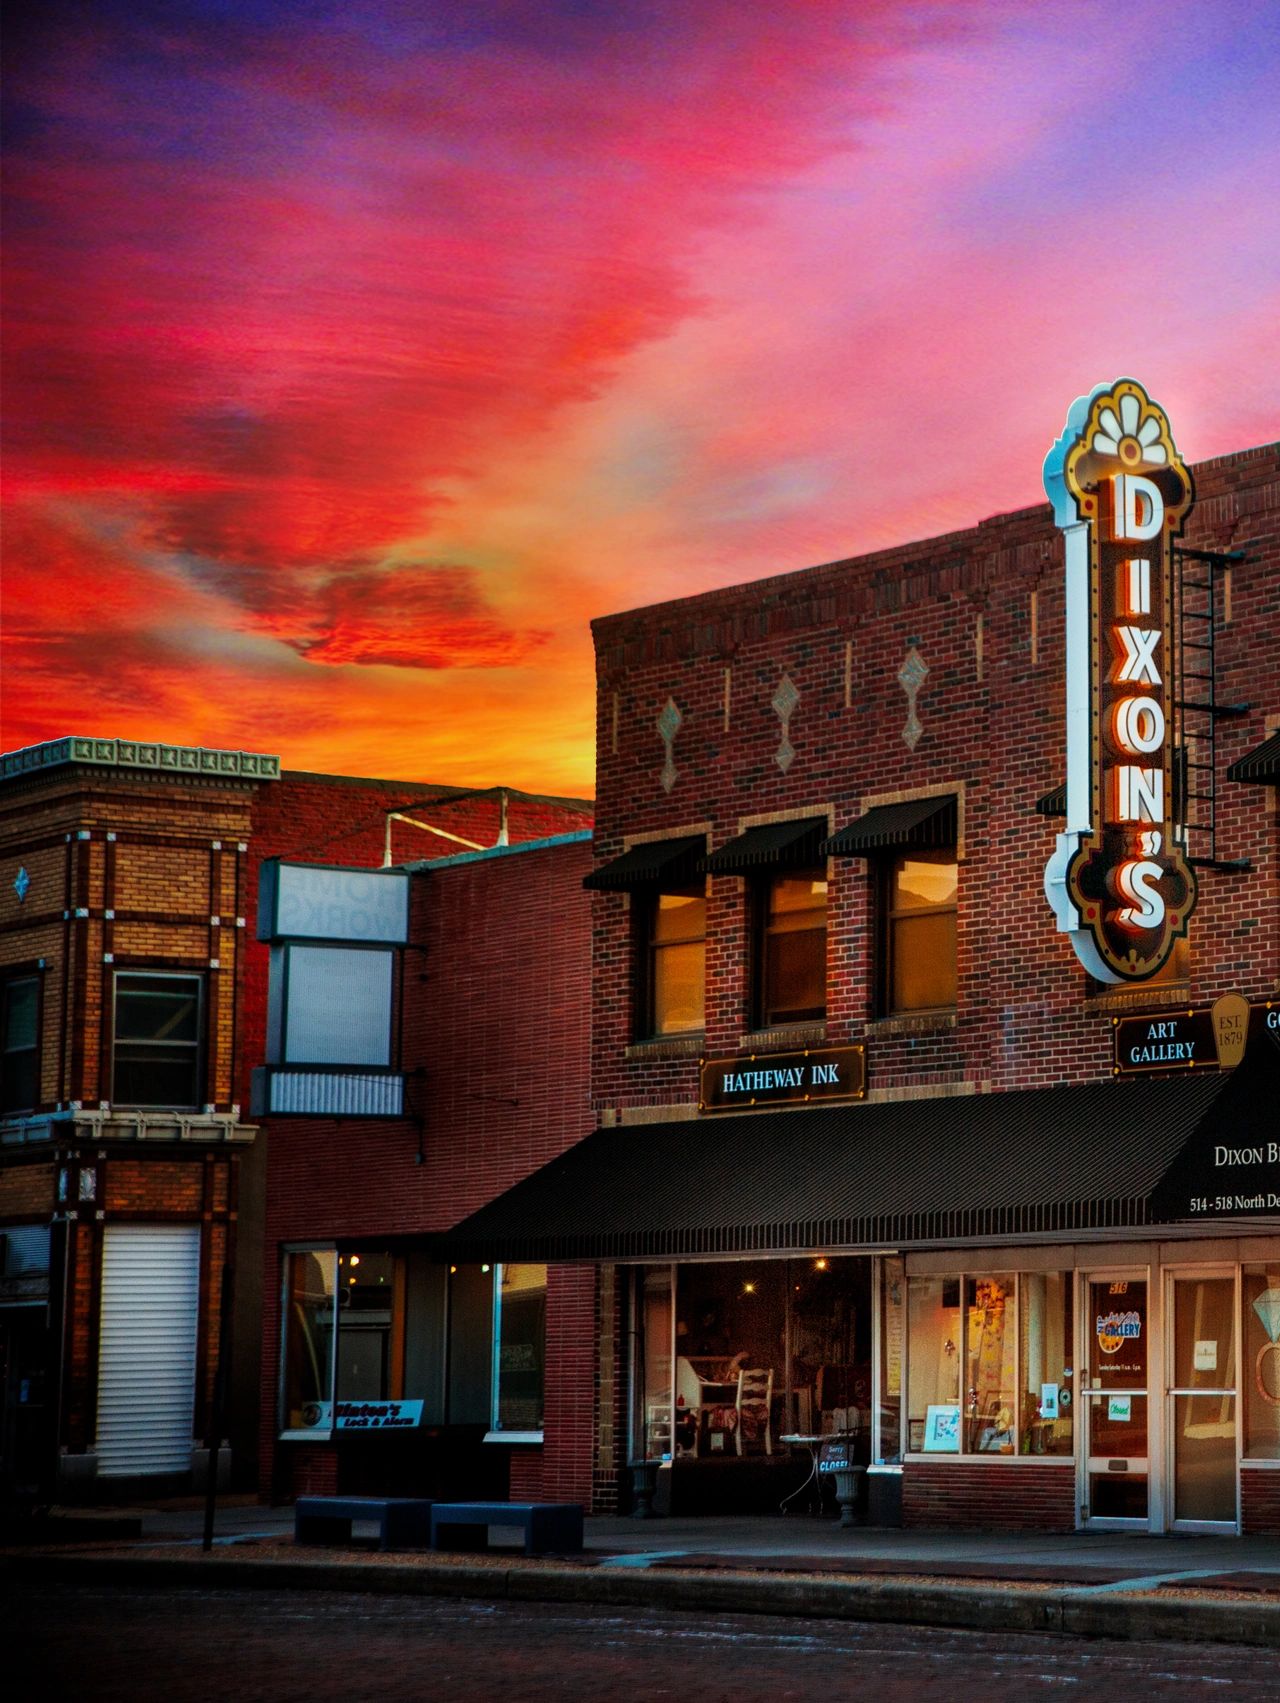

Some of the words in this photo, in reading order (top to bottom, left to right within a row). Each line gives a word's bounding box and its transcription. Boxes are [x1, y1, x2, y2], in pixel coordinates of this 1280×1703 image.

[1113, 473, 1165, 931] DIXON'S
[1147, 1021, 1178, 1040] ART
[1219, 1015, 1241, 1029] EST.
[1218, 1031, 1243, 1047] 1879
[1130, 1041, 1195, 1063] GALLERY
[722, 1066, 805, 1093] HATHEWAY
[811, 1063, 840, 1084] INK
[1214, 1145, 1263, 1167] DIXON
[1190, 1197, 1207, 1212] 514
[1215, 1196, 1233, 1210] 518
[1234, 1193, 1265, 1209] North
[1111, 1282, 1127, 1293] 516
[1105, 1323, 1140, 1336] GALLERY
